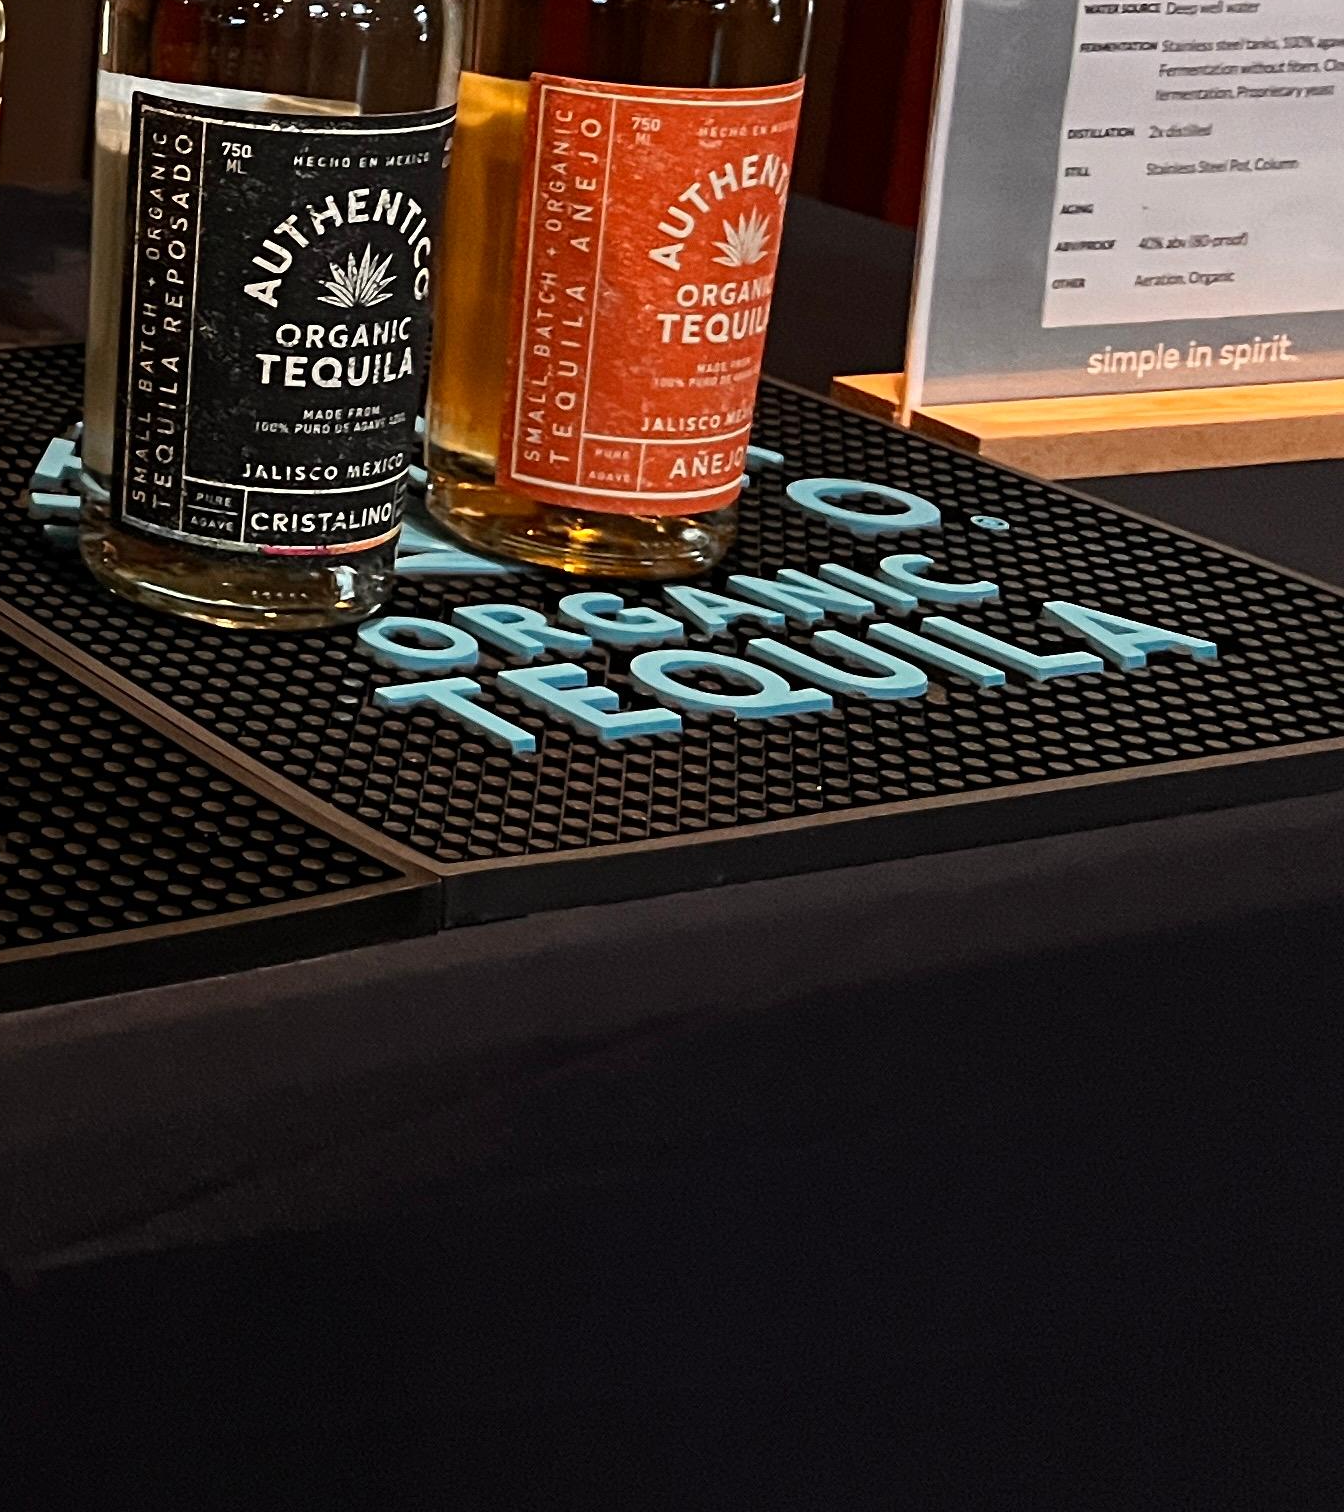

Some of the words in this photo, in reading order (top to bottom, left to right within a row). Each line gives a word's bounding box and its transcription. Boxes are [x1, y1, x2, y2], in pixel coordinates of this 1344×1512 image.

[221, 142, 253, 159] 750
[631, 116, 661, 131] 750
[146, 131, 167, 261] ORGANIC
[545, 109, 573, 232] ORGANIC
[163, 134, 193, 332] REPOSADO
[243, 188, 431, 308] AUTHENTICO
[137, 304, 158, 393] BATCH
[275, 316, 412, 349] ORGANIC
[533, 272, 557, 358] BATCH
[1087, 344, 1180, 378] simple
[1186, 341, 1212, 367] in
[1219, 333, 1299, 371] spirit.
[255, 347, 413, 388] TEQUILA
[549, 286, 586, 464] TEQUILA
[132, 412, 151, 503] SMALL
[152, 356, 180, 509] TEQUILA
[524, 375, 547, 462] SMALL
[641, 416, 721, 433] JALISCO
[242, 464, 339, 481] JALISCO
[346, 452, 404, 479] MEXICO
[669, 450, 746, 480] AÑEJO
[250, 502, 393, 533] CRISTALINO
[357, 553, 1000, 672] ORGANIC
[376, 601, 1218, 753] TEQUILA
